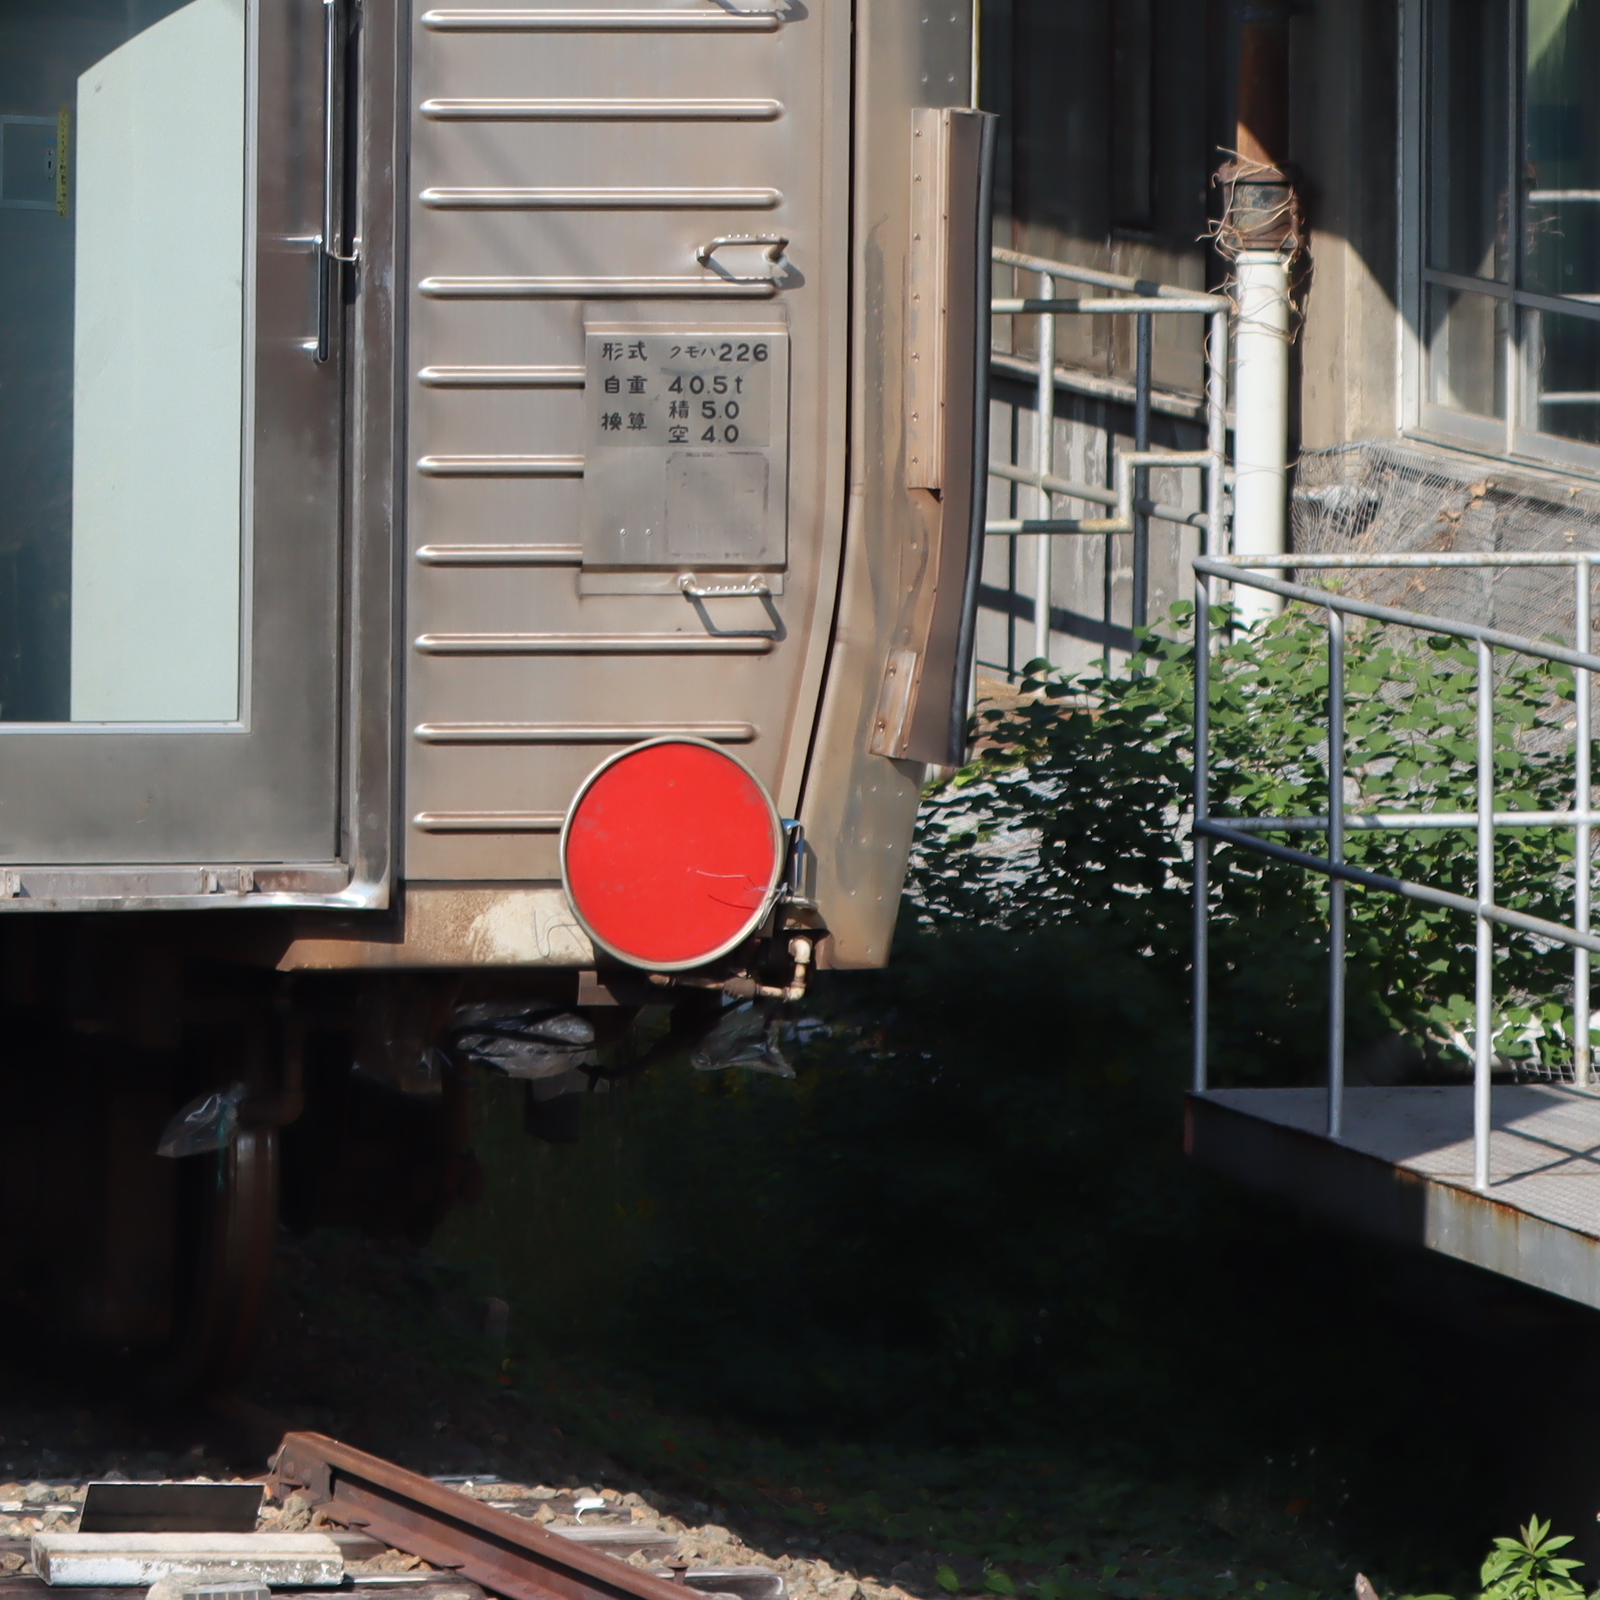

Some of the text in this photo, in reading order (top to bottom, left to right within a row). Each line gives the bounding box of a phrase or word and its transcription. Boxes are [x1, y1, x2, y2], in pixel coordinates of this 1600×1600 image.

[601, 340, 769, 363] 形式 クモハ226
[604, 374, 648, 394] 自重
[668, 399, 740, 420] 積 5.0
[601, 411, 648, 431] 換算
[668, 424, 740, 444] 空 4.0
